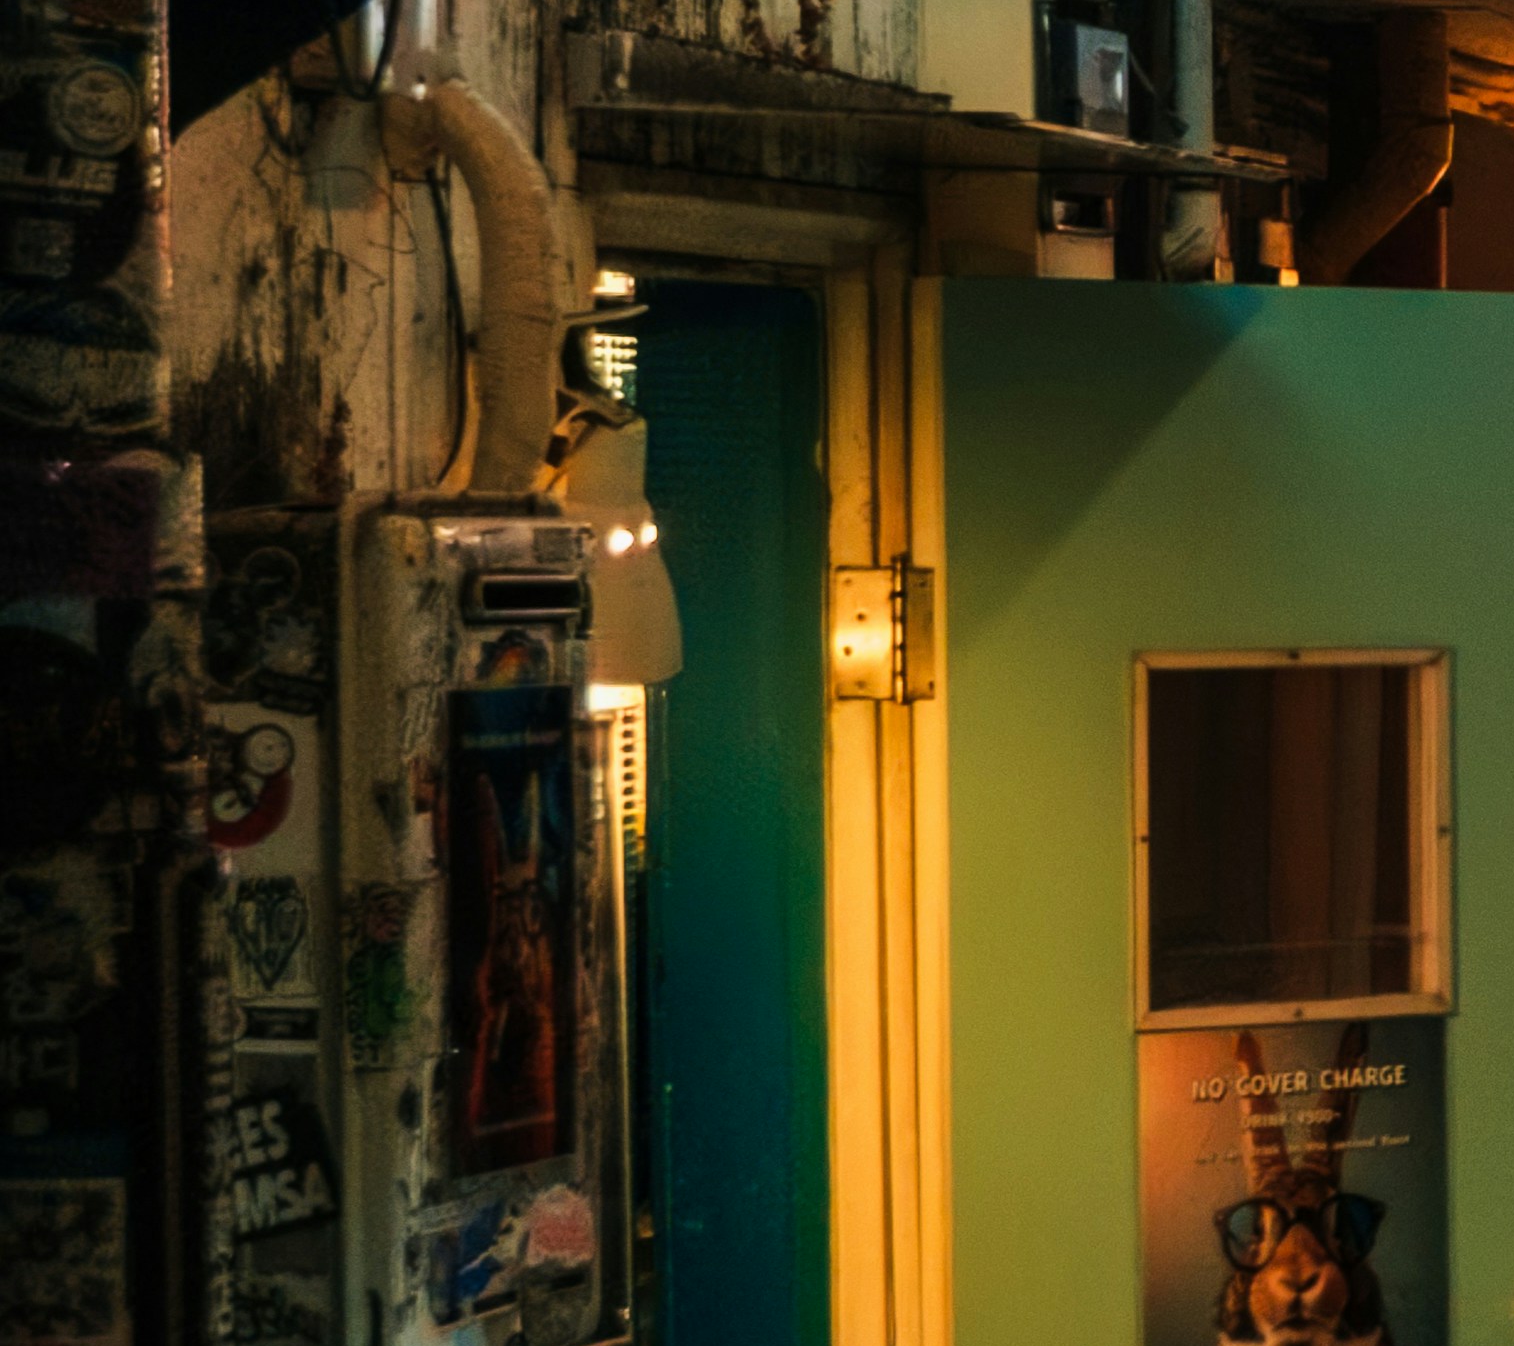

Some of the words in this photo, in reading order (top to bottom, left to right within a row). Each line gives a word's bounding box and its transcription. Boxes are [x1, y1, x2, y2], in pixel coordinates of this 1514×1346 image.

[1192, 1075, 1225, 1102] NO
[1236, 1070, 1308, 1097] COVER
[1319, 1063, 1407, 1091] CHARGE
